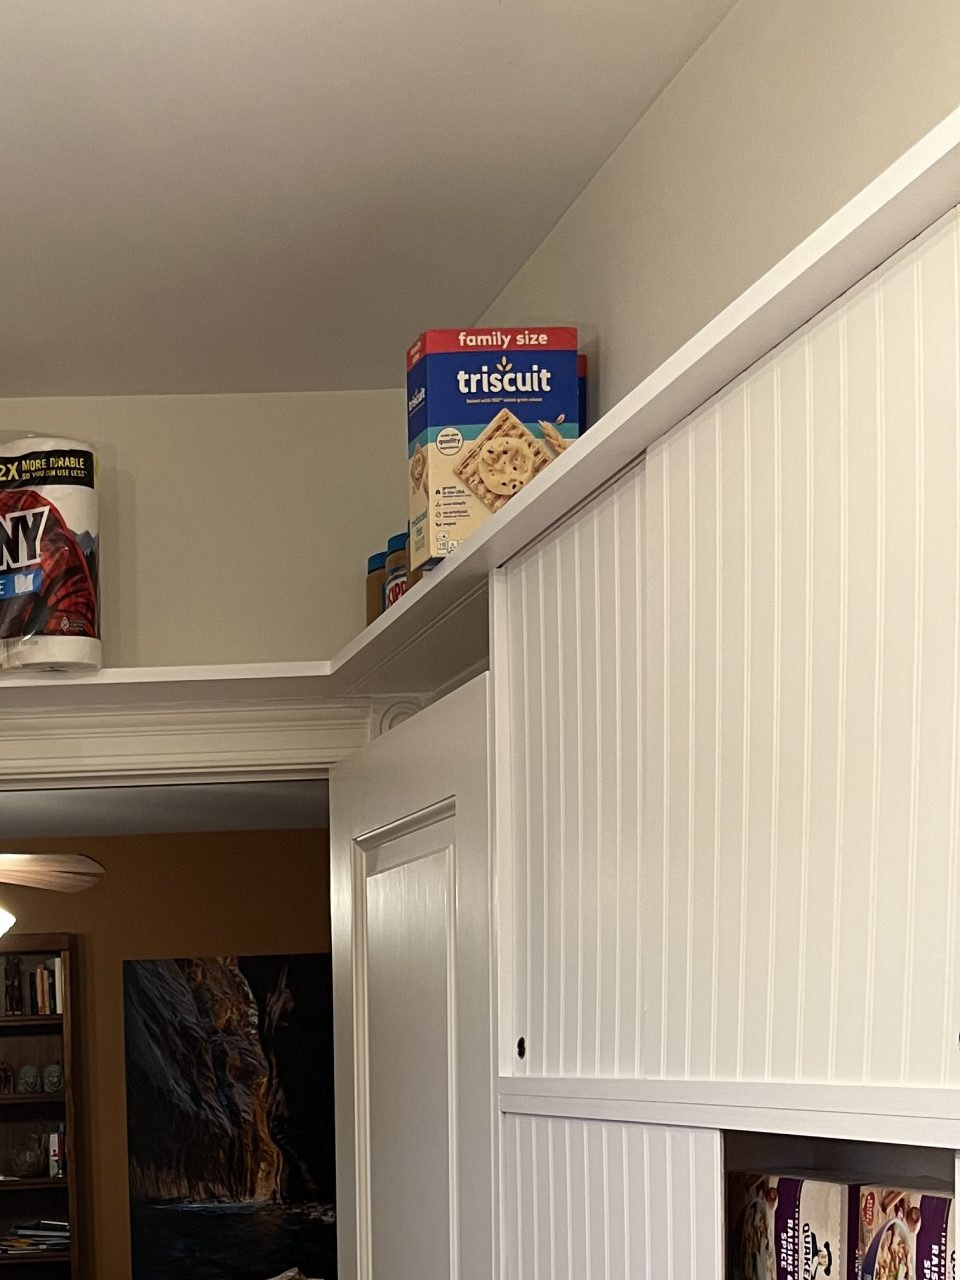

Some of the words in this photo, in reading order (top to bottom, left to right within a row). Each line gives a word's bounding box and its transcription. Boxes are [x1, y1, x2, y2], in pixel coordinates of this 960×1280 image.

[458, 332, 511, 349] family
[516, 330, 548, 345] size
[457, 364, 551, 394] triscuit
[21, 458, 47, 471] MORE
[786, 1219, 794, 1272] RAISINS
